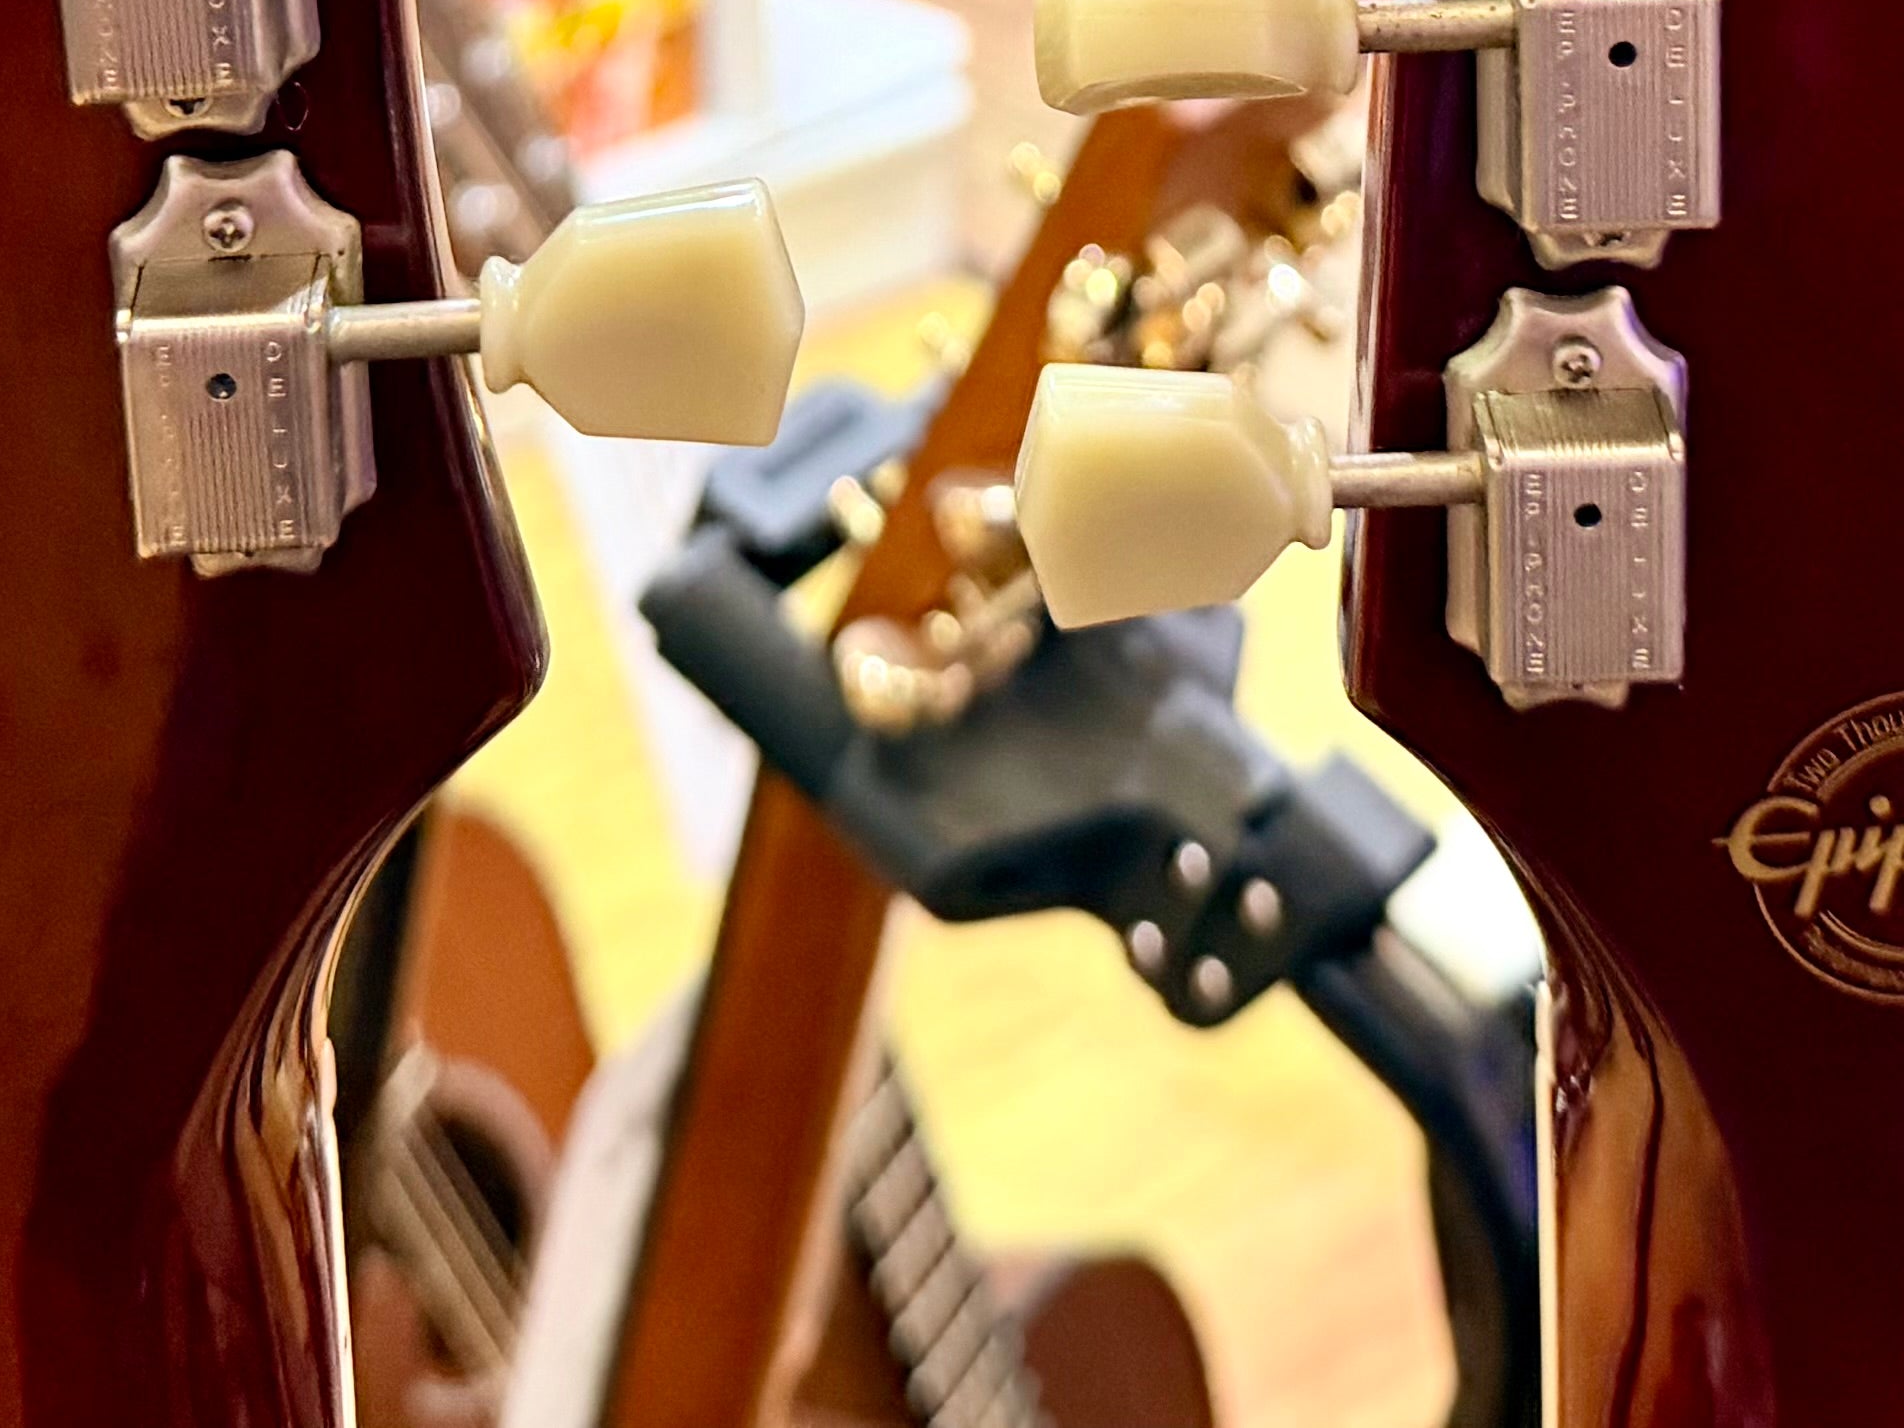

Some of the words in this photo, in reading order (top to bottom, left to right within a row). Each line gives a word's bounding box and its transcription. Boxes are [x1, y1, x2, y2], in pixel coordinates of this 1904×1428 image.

[1557, 10, 1581, 221] EPIPHONE
[1664, 8, 1689, 217] DELUXE
[263, 340, 297, 541] DELUXE
[1523, 470, 1546, 675] EPIPHONE
[1628, 470, 1652, 671] DELUXE
[1783, 747, 1841, 794] Two
